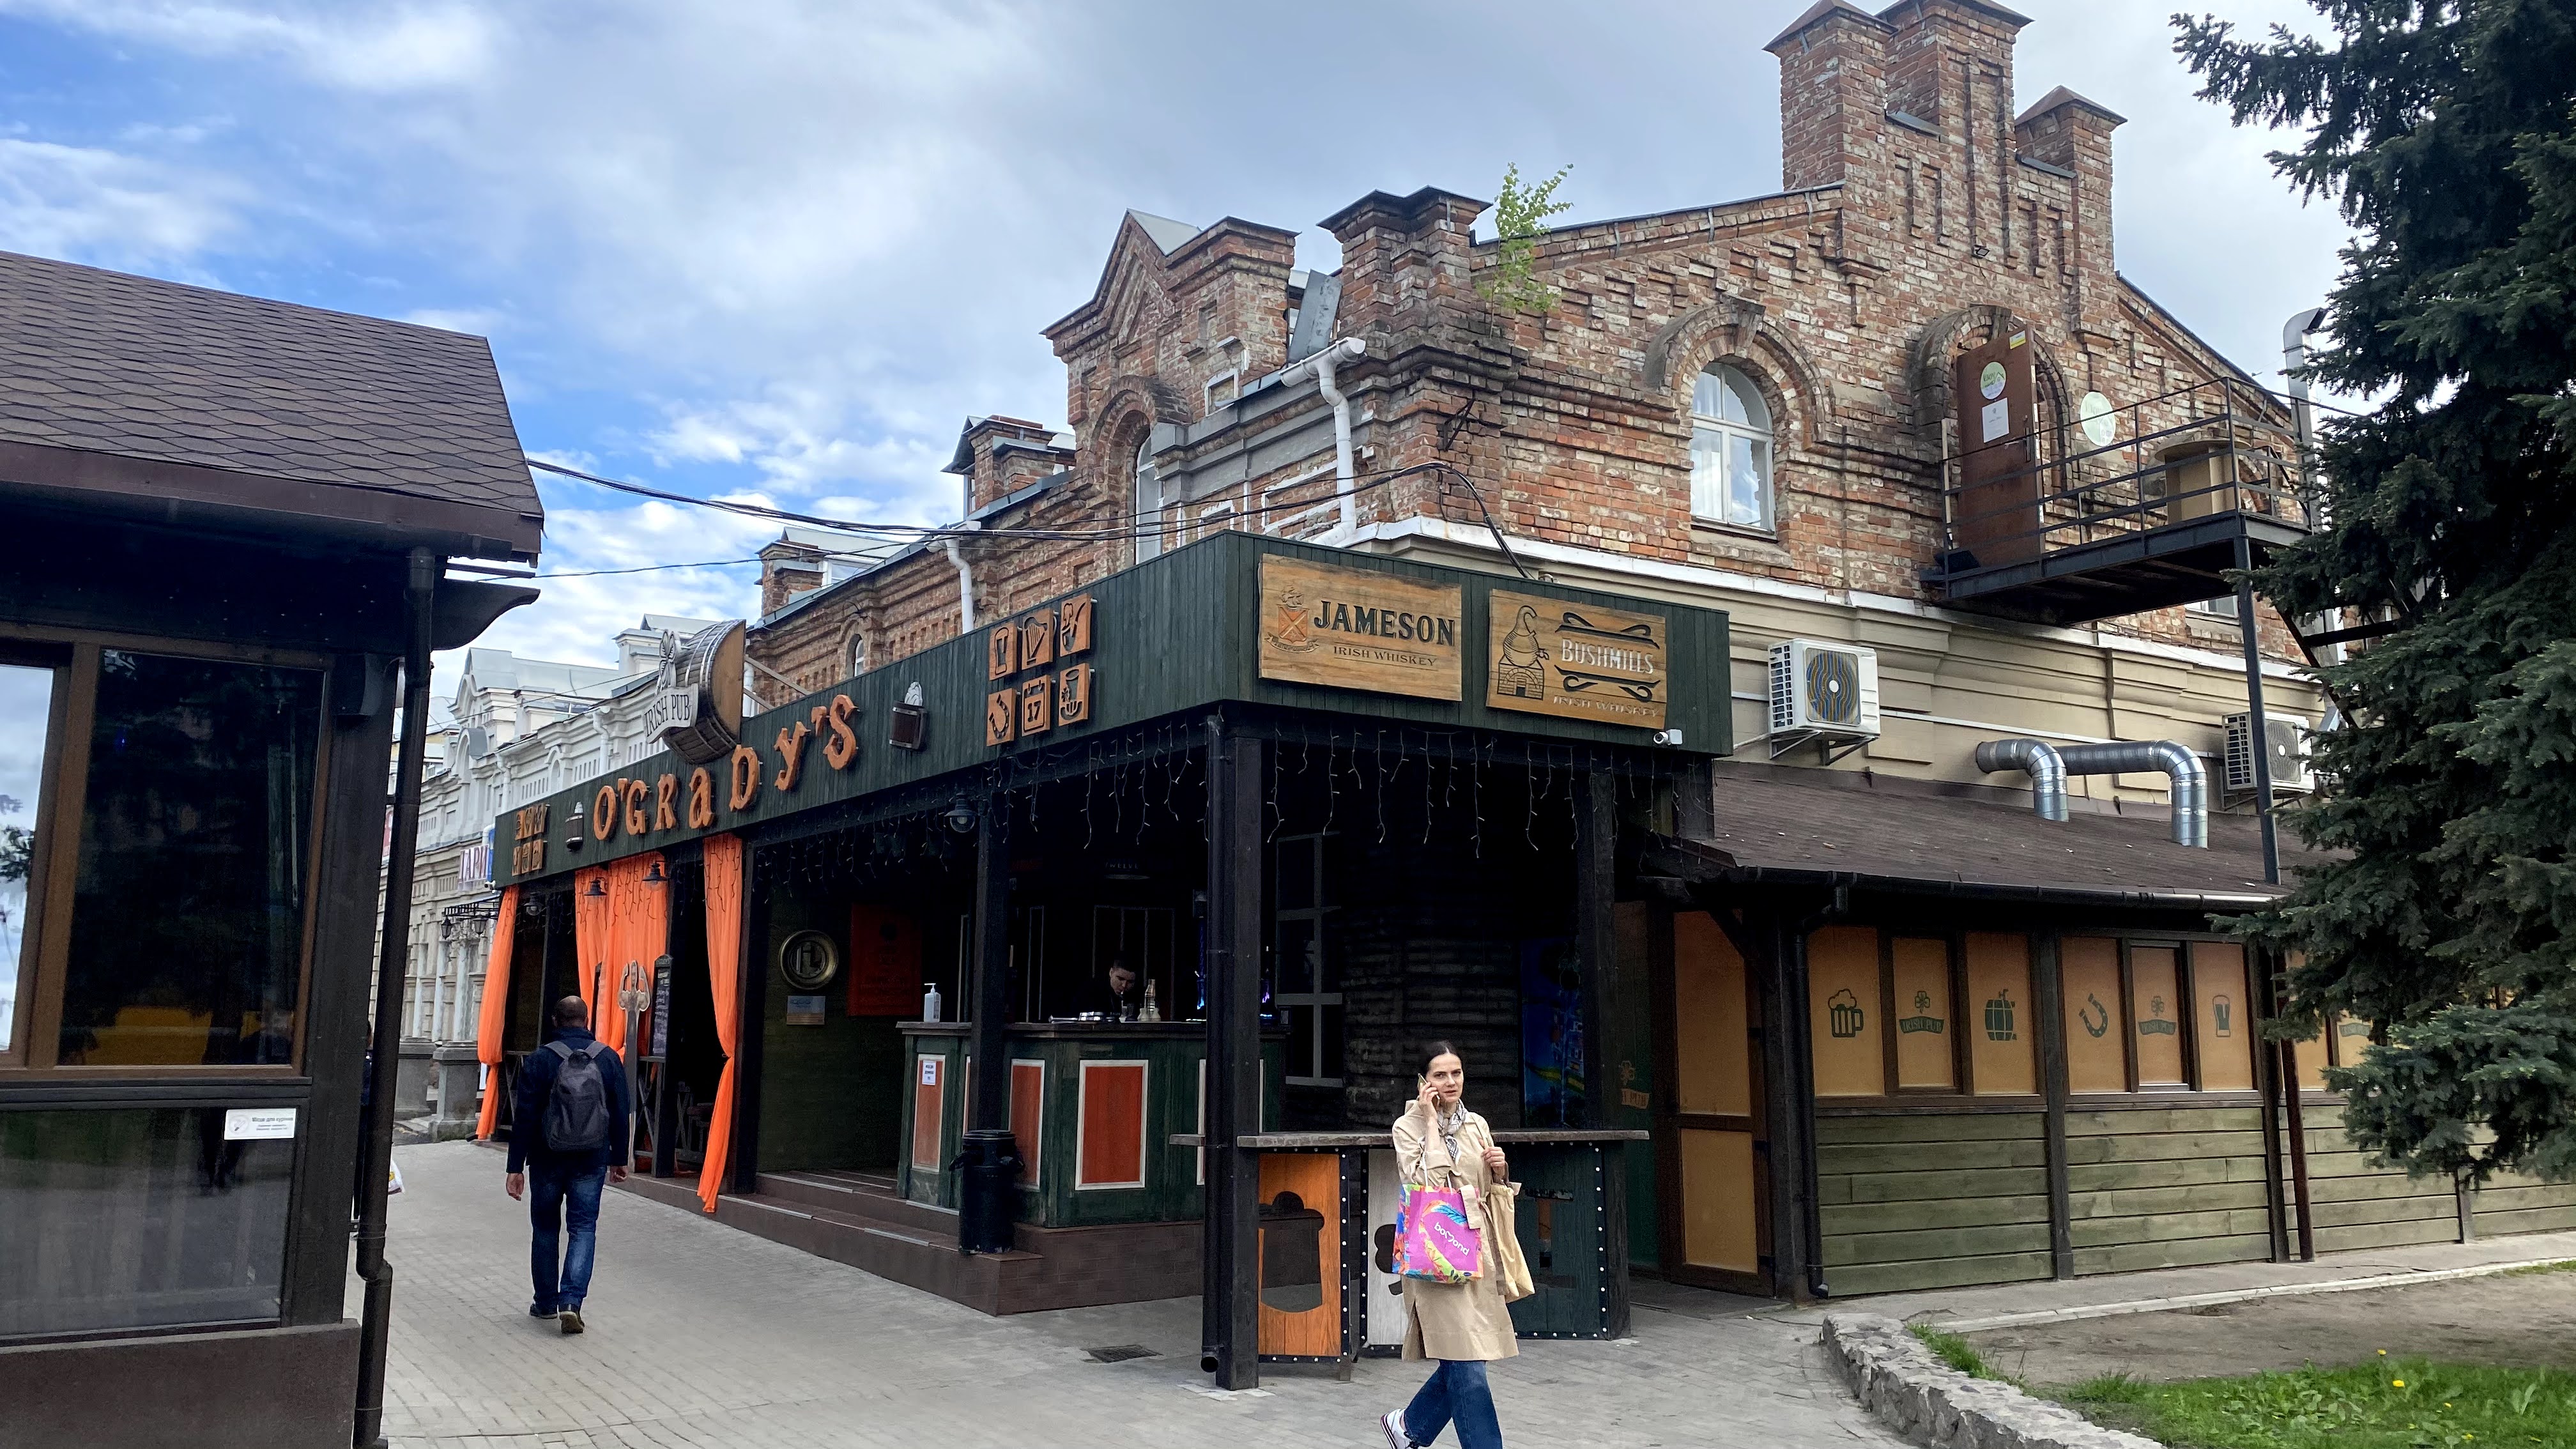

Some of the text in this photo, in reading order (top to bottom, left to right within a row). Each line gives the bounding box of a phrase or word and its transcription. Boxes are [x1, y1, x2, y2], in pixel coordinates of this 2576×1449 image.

[1314, 600, 1455, 647] JAMESON
[1333, 646, 1438, 667] IRISH WHISKEY
[1561, 637, 1654, 675] BUSHMILLS
[644, 694, 690, 737] IRISH PUB
[1027, 700, 1041, 722] 17
[1553, 694, 1660, 717] IRISH WHISKEY
